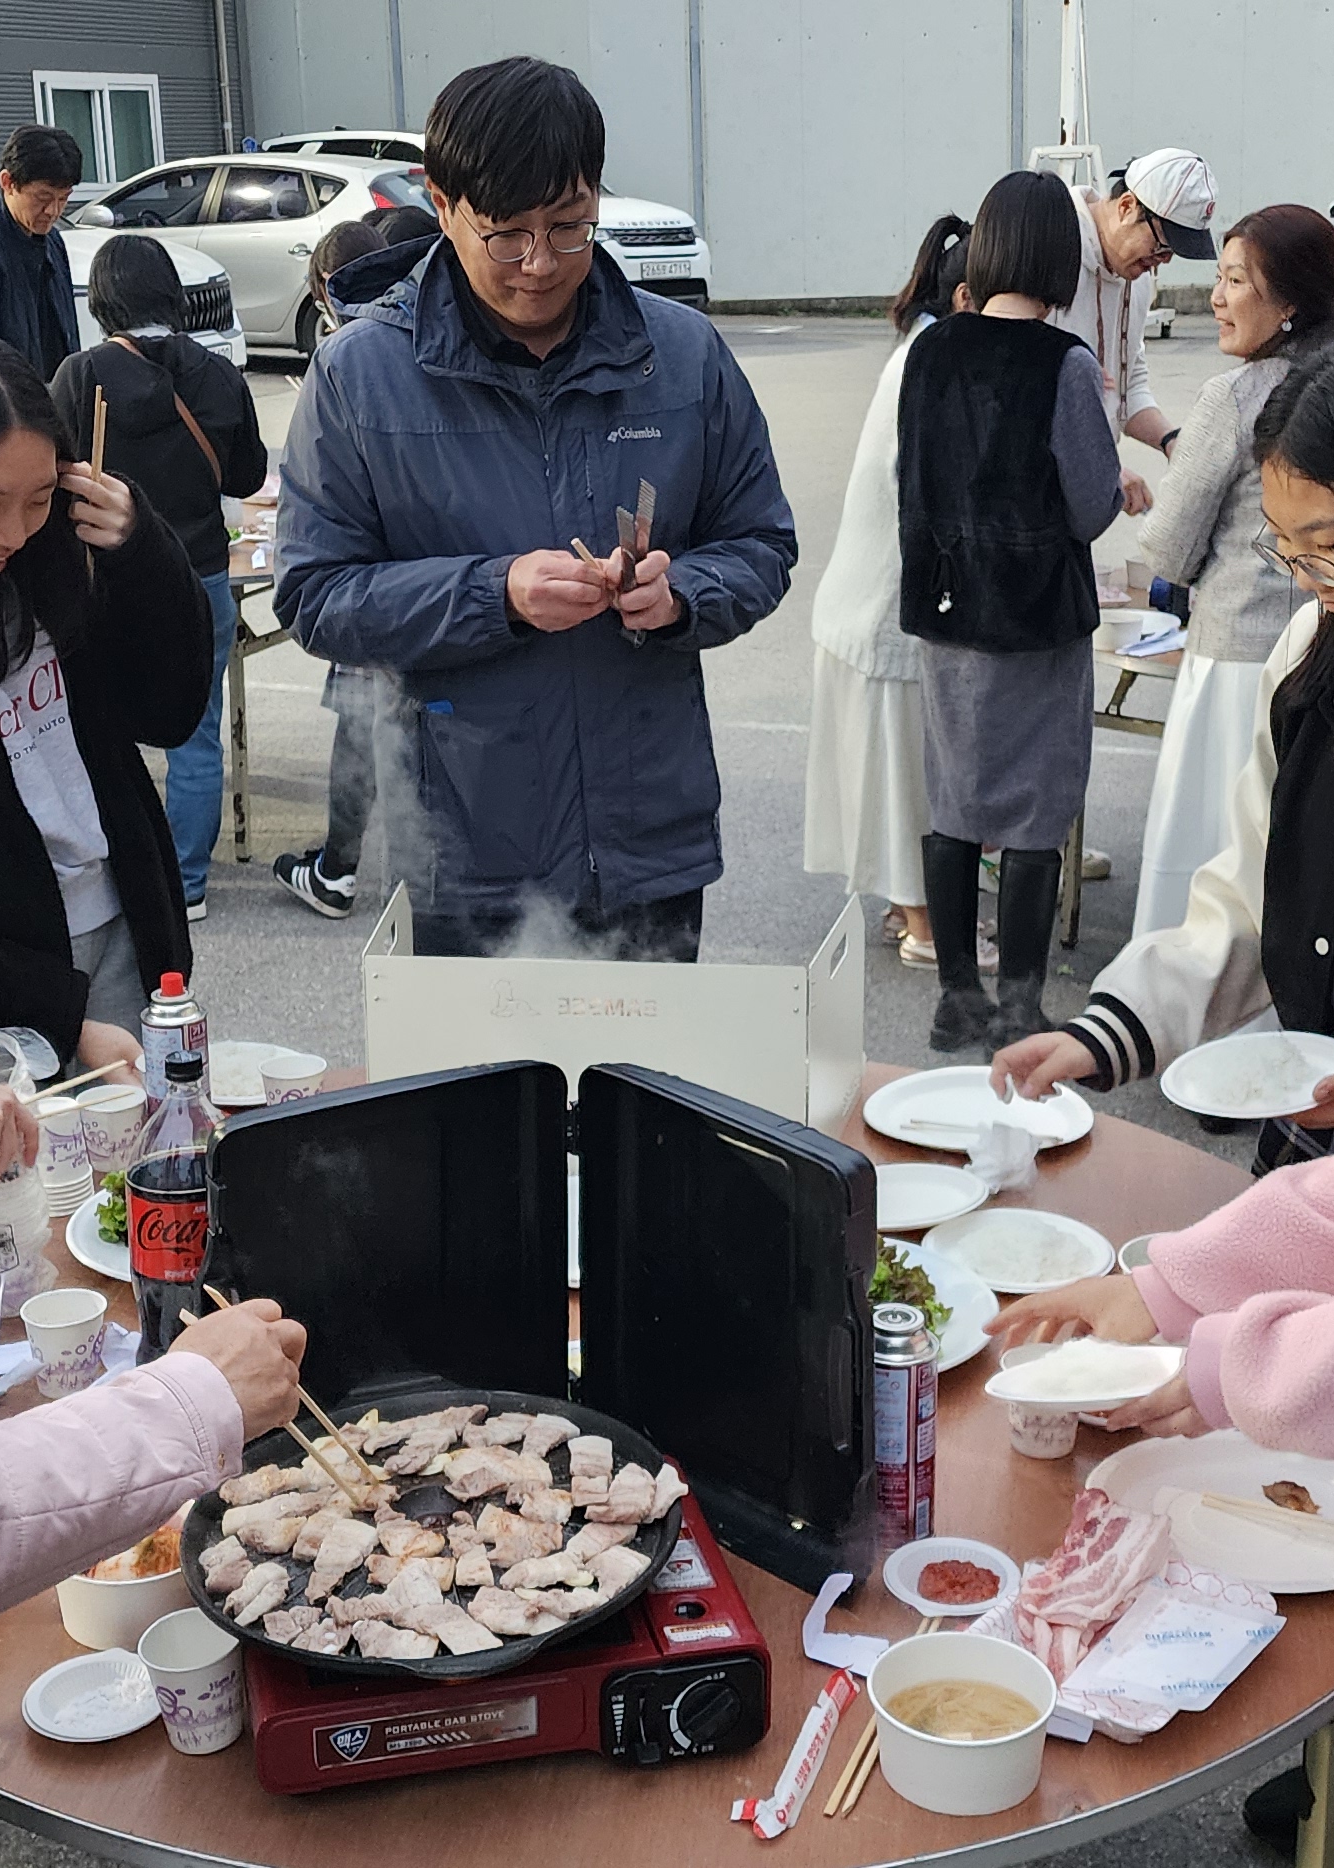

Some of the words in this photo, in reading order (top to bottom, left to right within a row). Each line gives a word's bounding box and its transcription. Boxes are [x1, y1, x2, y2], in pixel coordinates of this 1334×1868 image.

[618, 426, 662, 440] Columbia
[38, 716, 66, 735] AUTO
[385, 1719, 441, 1735] PORTABLE
[445, 1715, 467, 1727] GAS
[470, 1710, 505, 1723] STOVE
[337, 1730, 364, 1749] 맥스
